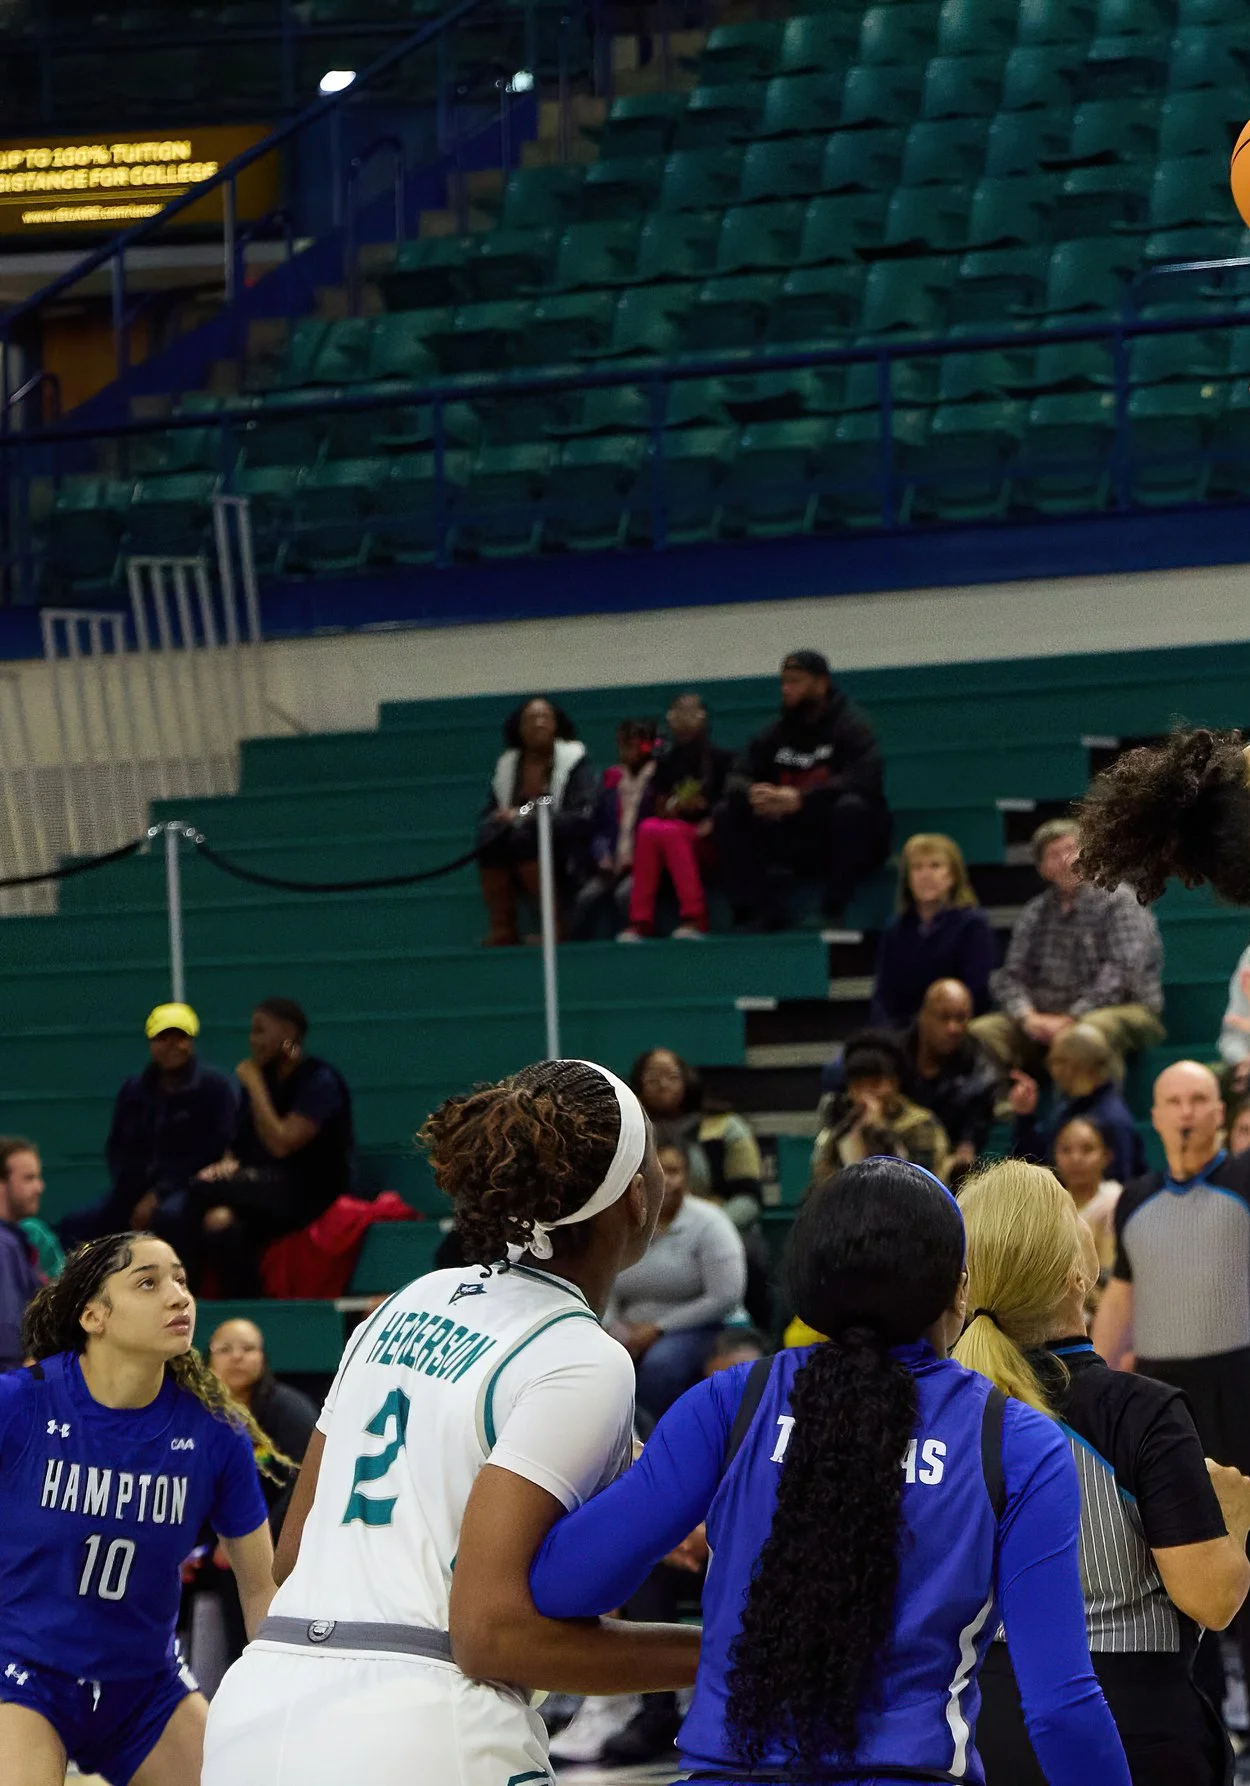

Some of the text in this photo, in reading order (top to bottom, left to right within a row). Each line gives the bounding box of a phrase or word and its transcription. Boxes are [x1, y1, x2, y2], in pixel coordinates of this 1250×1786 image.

[24, 148, 52, 168] TO
[51, 144, 112, 168] 100%
[110, 140, 191, 164] TUITION
[89, 166, 130, 188] FOR
[129, 161, 218, 186] COLLEGE
[171, 1438, 195, 1451] CAA
[340, 1387, 411, 1528] 2
[769, 1414, 948, 1486] TAS
[41, 1459, 188, 1525] HAMPTON
[78, 1534, 136, 1601] 10
